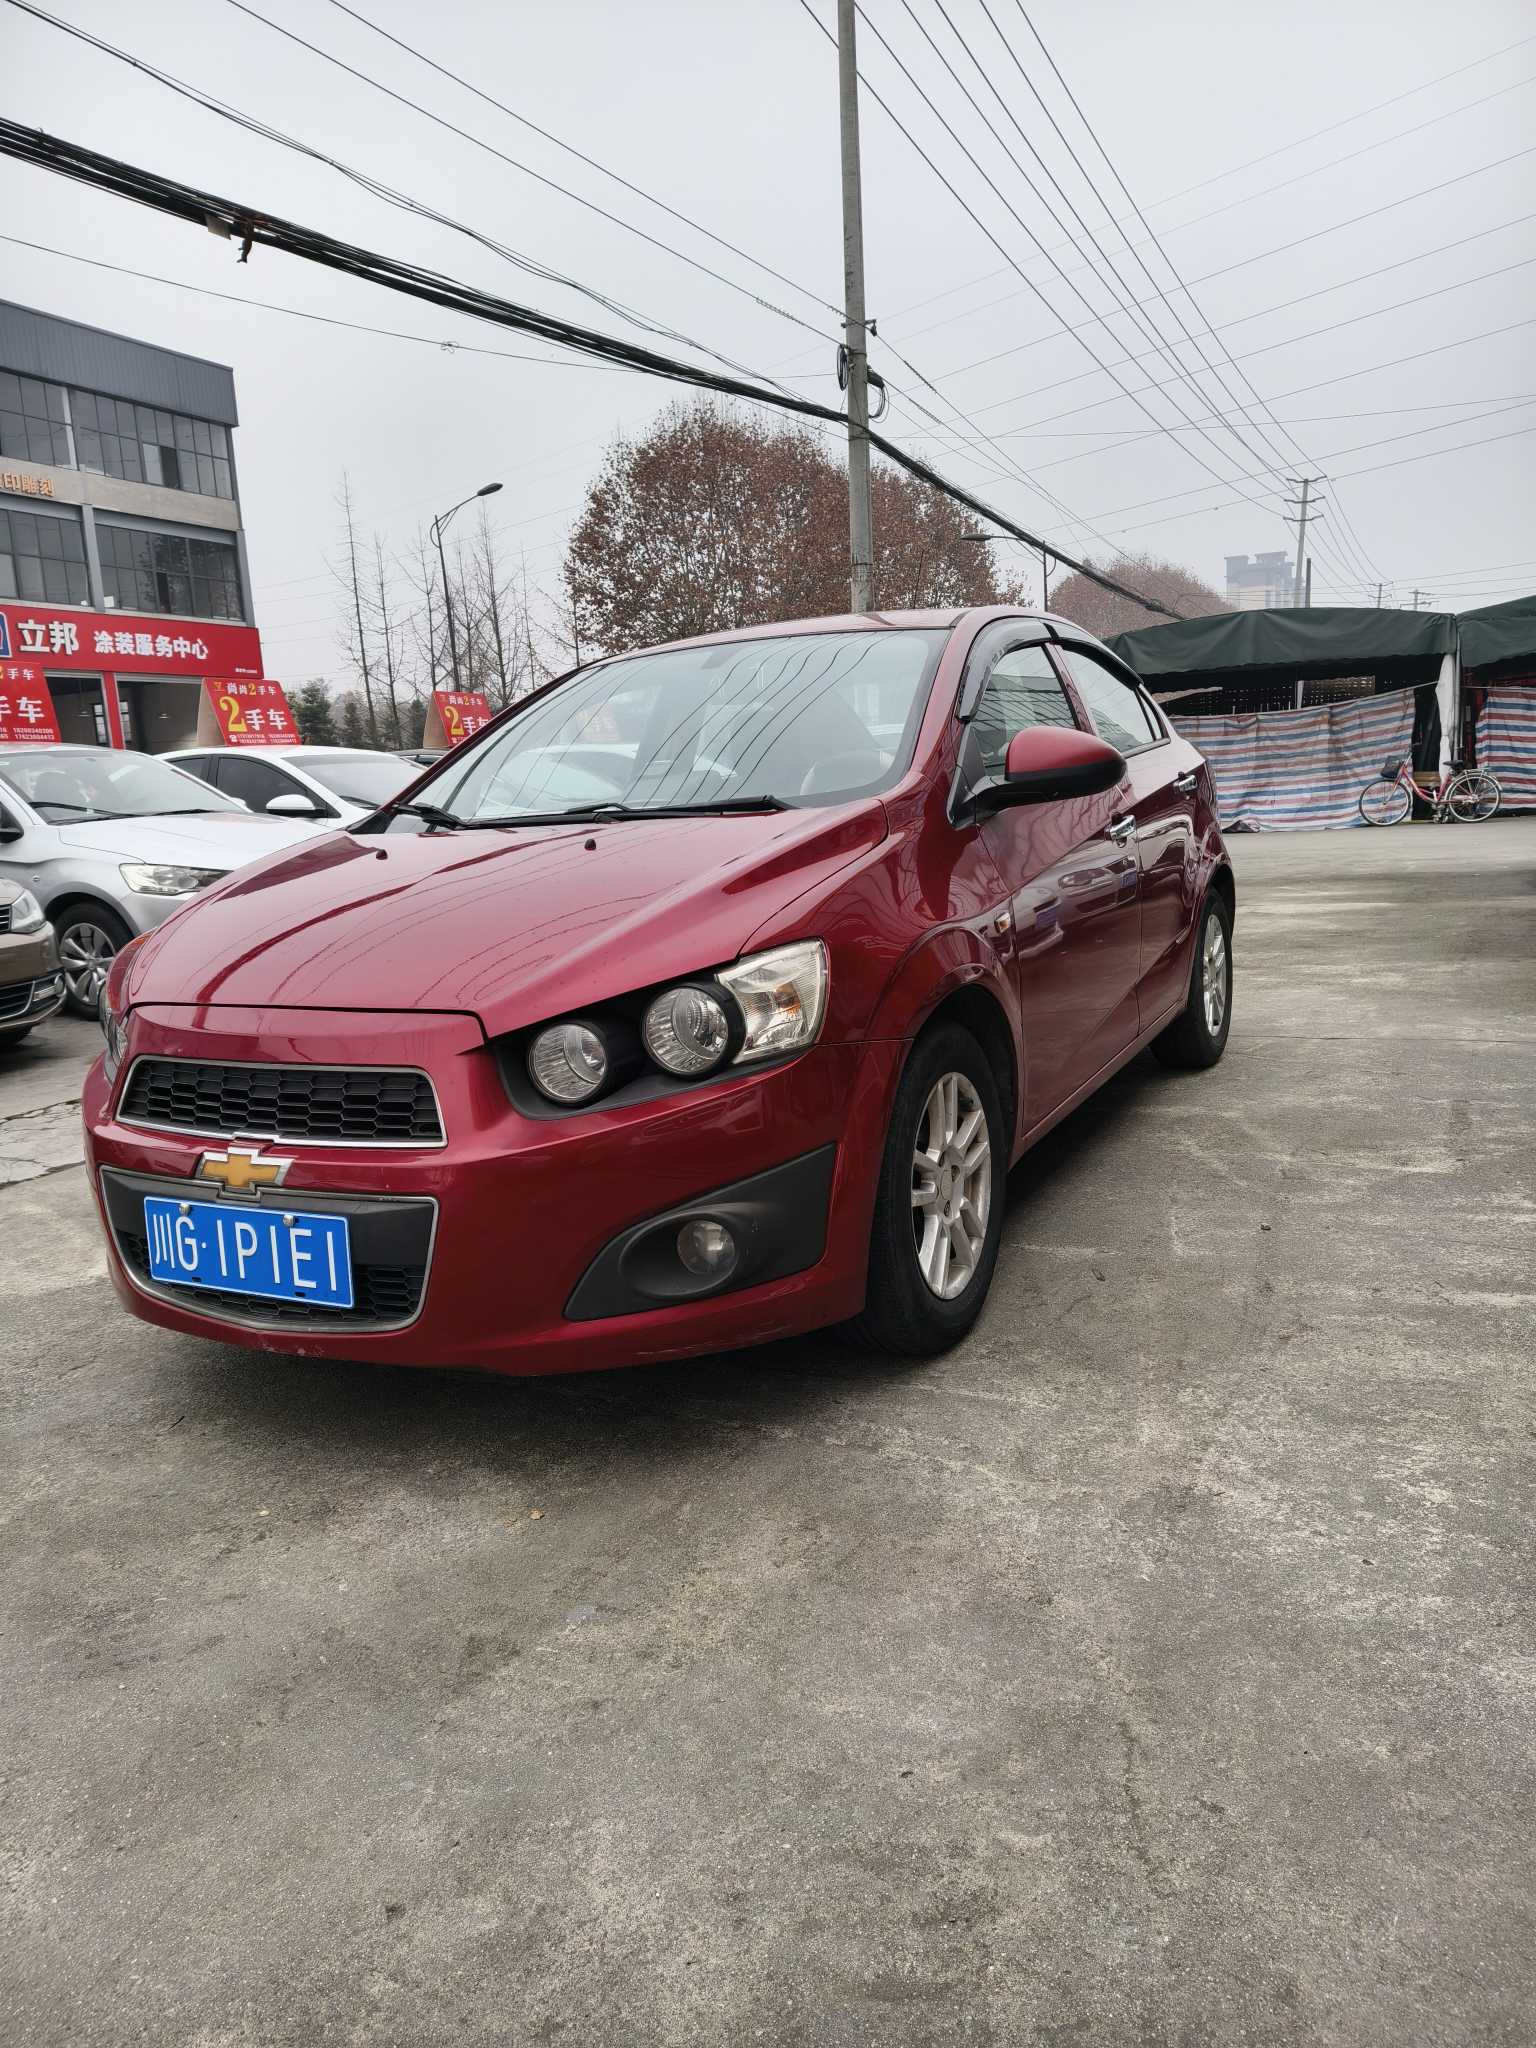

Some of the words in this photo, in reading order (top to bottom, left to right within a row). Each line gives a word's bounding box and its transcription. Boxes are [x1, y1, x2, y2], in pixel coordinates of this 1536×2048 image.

[0, 472, 55, 497] 印雕刻
[17, 619, 80, 655] 立邦
[93, 630, 209, 659] 涂装服务中心
[219, 695, 288, 733] 2手车
